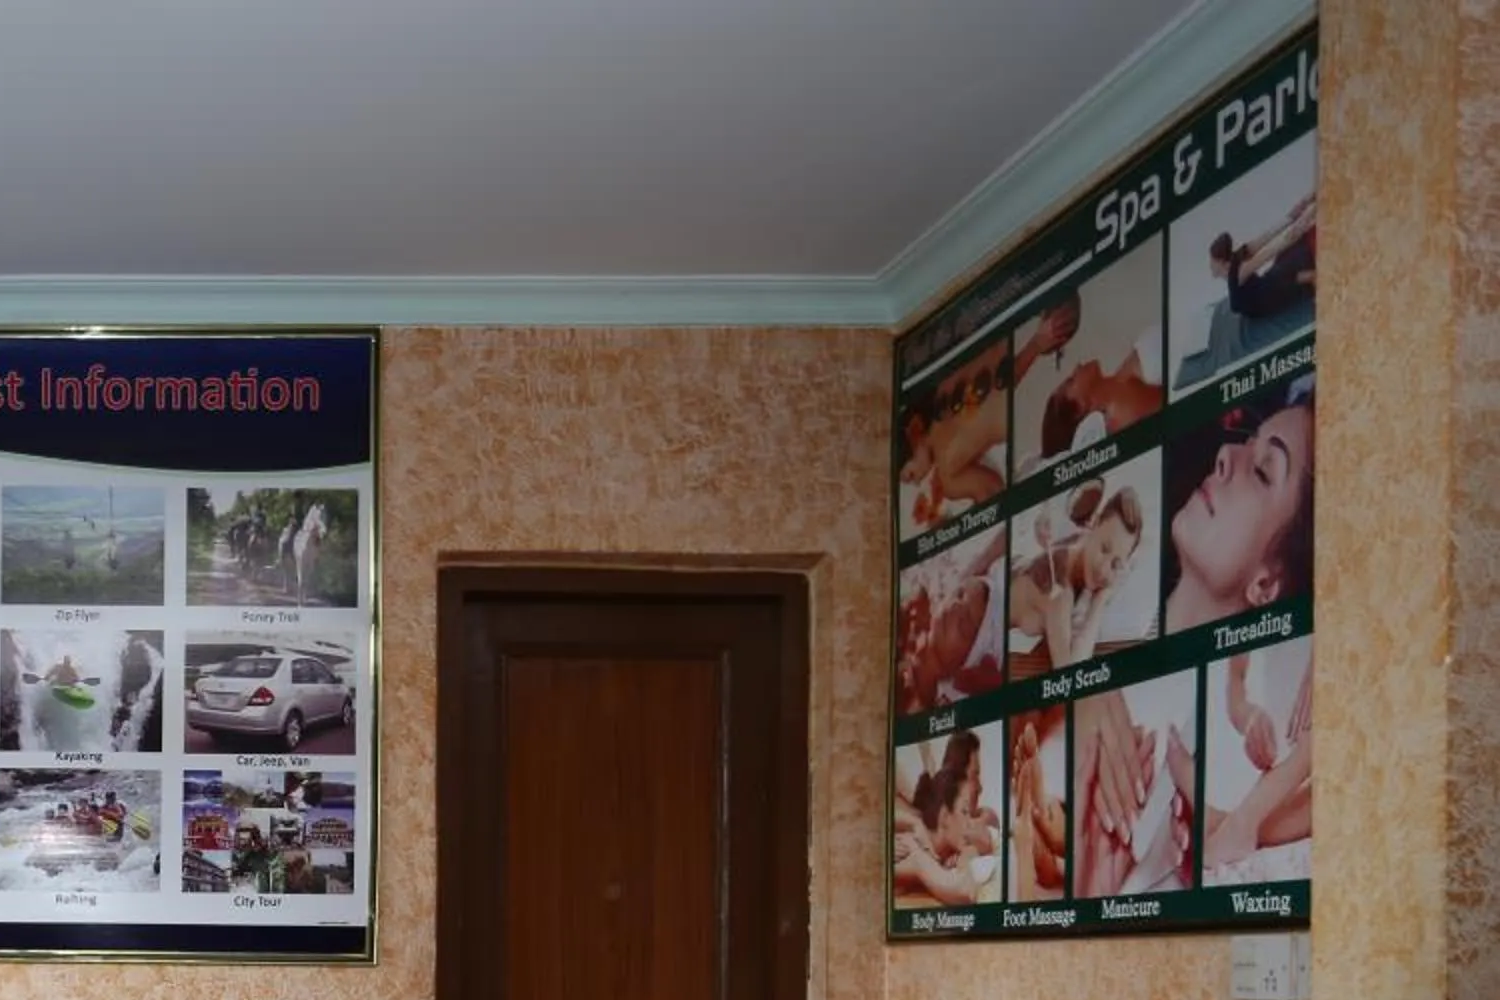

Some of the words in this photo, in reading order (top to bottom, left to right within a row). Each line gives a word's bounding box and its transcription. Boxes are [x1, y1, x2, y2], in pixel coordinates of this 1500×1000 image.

[1095, 172, 1162, 254] Spa
[1172, 132, 1203, 196] &
[40, 363, 321, 412] Information
[1220, 367, 1256, 404] Thai
[1053, 442, 1118, 487] Shirodhara
[54, 608, 75, 622] Zip
[76, 608, 100, 623] Flyer
[278, 611, 301, 623] Trek
[1213, 611, 1293, 651] Threading
[1042, 672, 1073, 698] Body
[1075, 663, 1112, 690] Scrub
[928, 709, 956, 733] Facial
[55, 751, 104, 764] Kayaking
[290, 755, 311, 766] Van
[233, 895, 256, 909] City
[258, 895, 283, 907] Tour
[1102, 896, 1162, 919] Manicure
[1230, 889, 1292, 917] Waxing
[911, 912, 935, 932] Body
[937, 910, 977, 931] Massage
[1003, 909, 1028, 928] Foot
[1029, 907, 1077, 928] Massage
